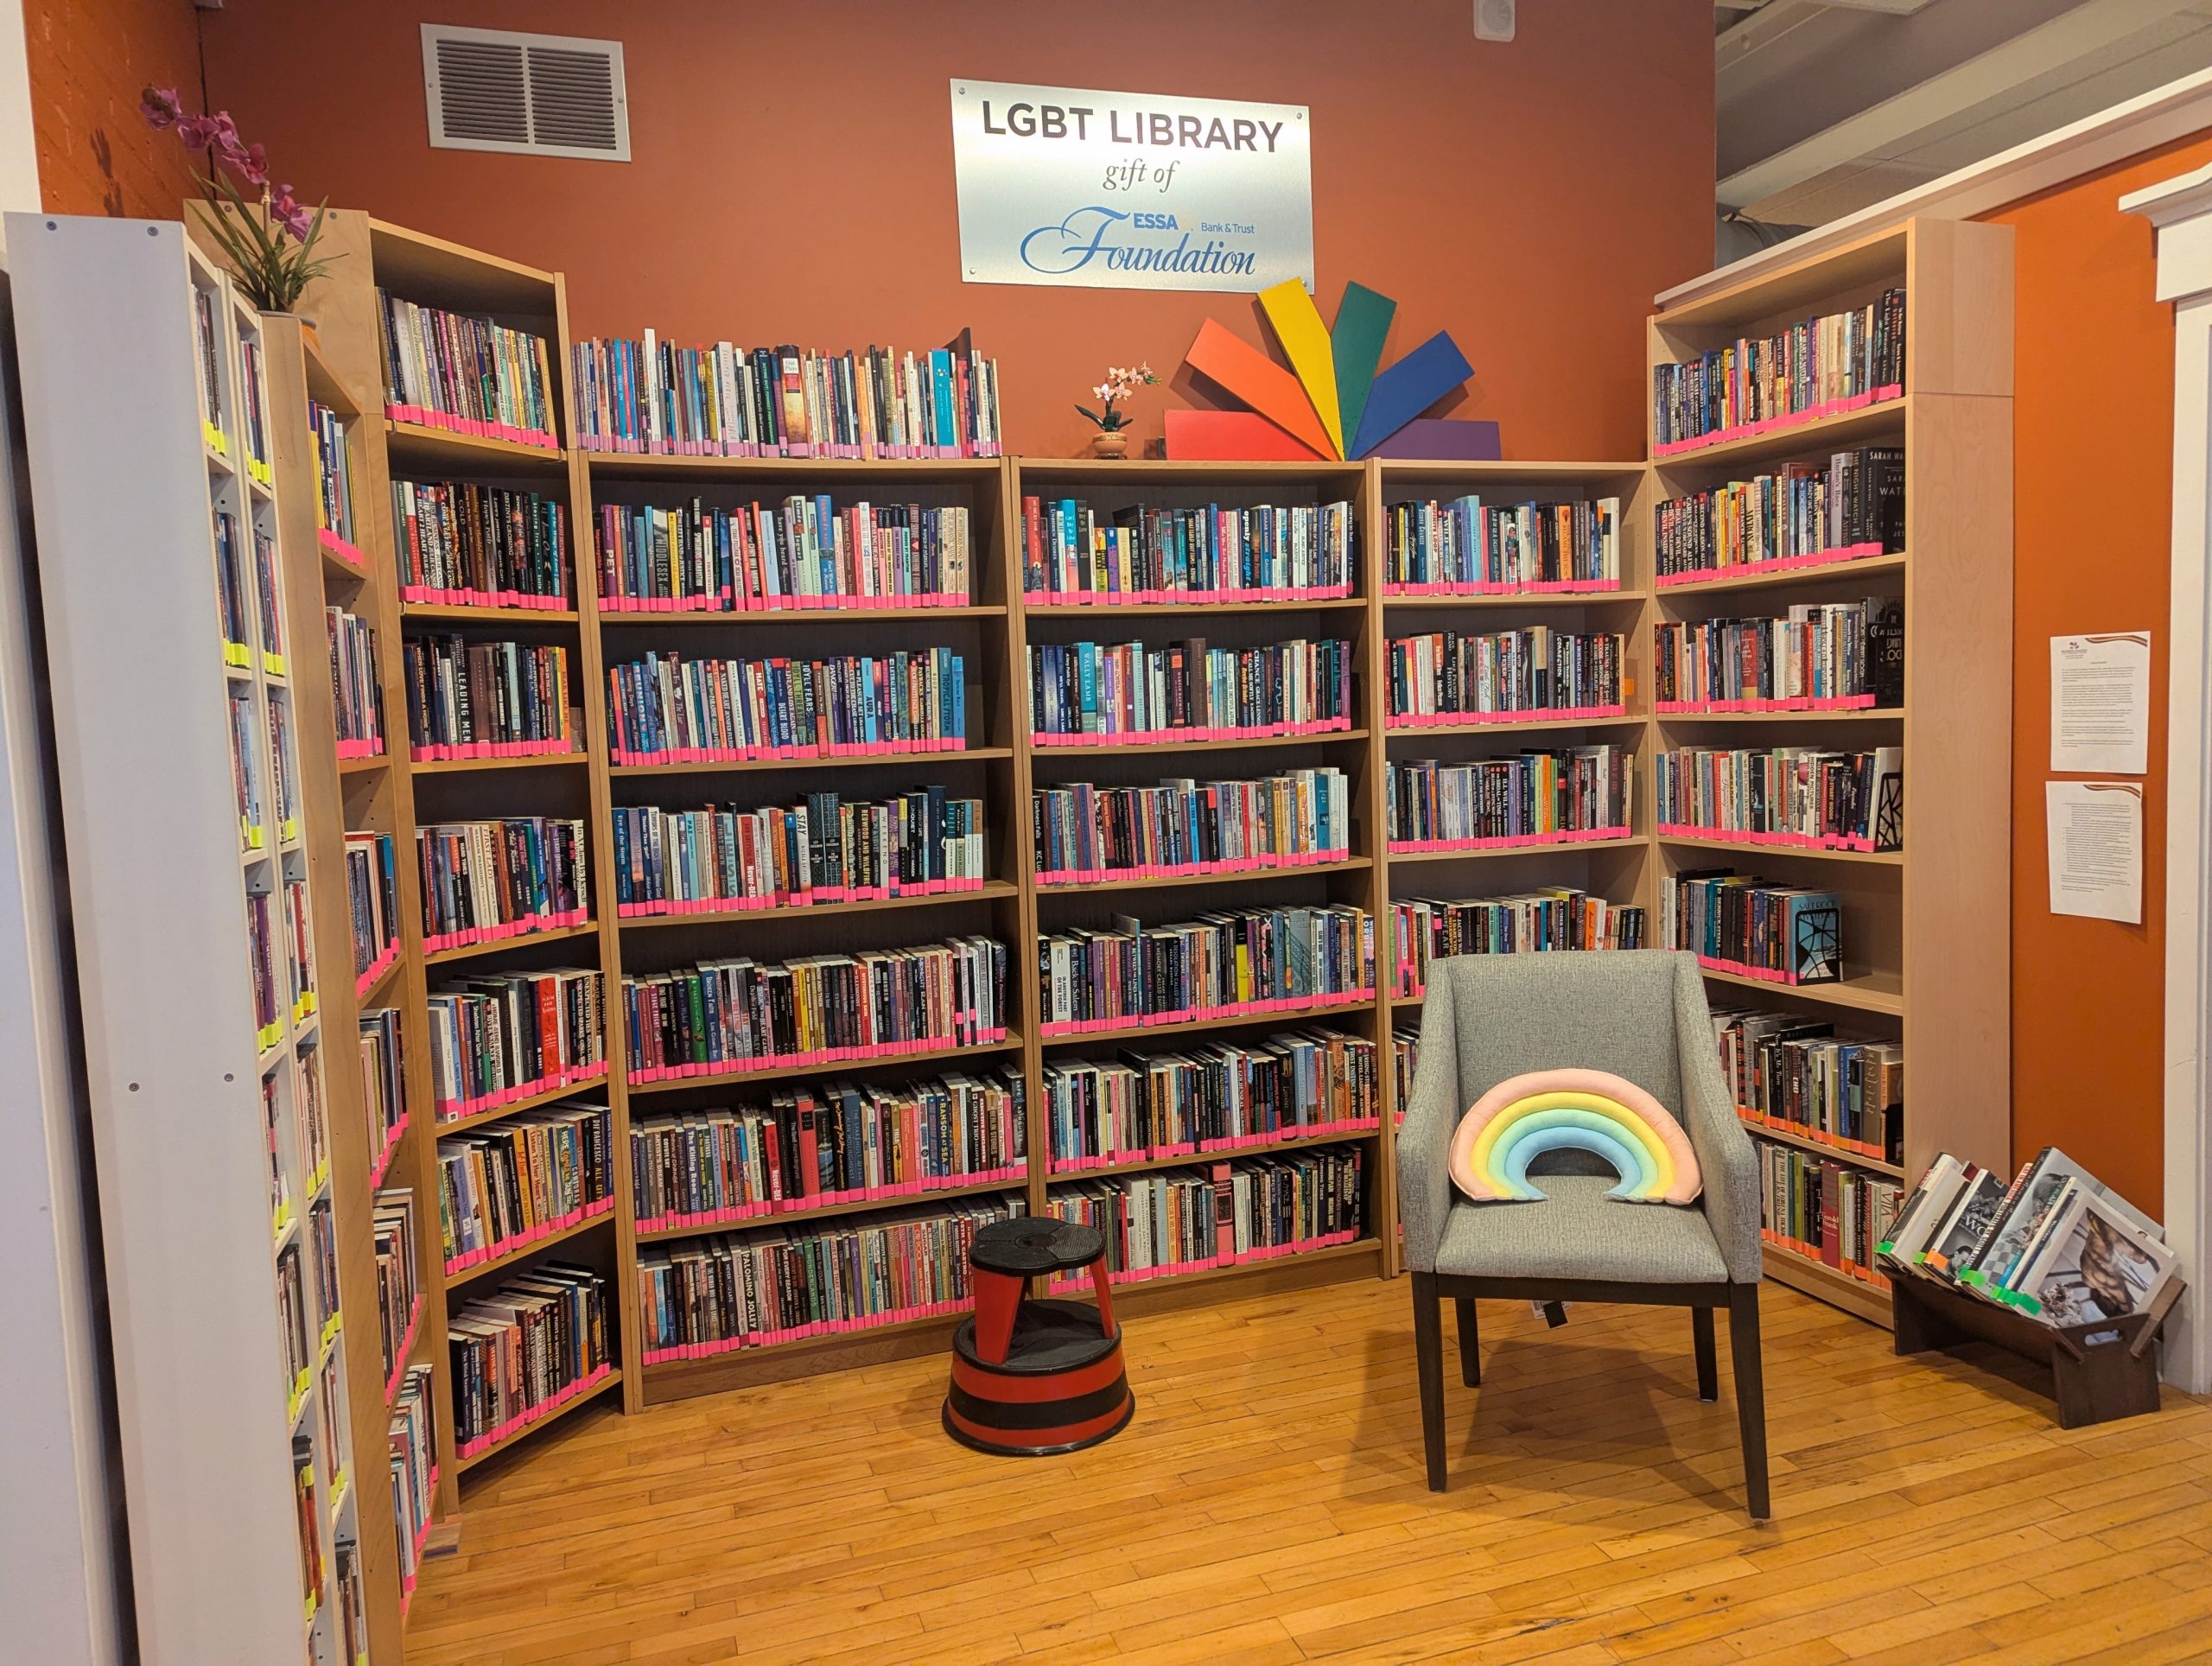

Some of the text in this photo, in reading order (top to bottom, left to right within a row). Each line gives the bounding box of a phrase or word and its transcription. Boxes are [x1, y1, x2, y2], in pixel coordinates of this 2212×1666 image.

[982, 100, 1283, 153] LGBT LIBRARY
[1103, 158, 1180, 193] gift of
[1133, 213, 1179, 230] ESSA
[1201, 222, 1255, 234] Bank & Trust
[1020, 207, 1256, 275] Foundation
[1870, 451, 1891, 460] SARAH
[607, 549, 615, 576] PET
[655, 538, 667, 582] MIDDLESEX
[633, 665, 645, 722] REUNION
[797, 814, 806, 836] STAY
[562, 1131, 570, 1150] HERE
[688, 1146, 696, 1171] Killing
